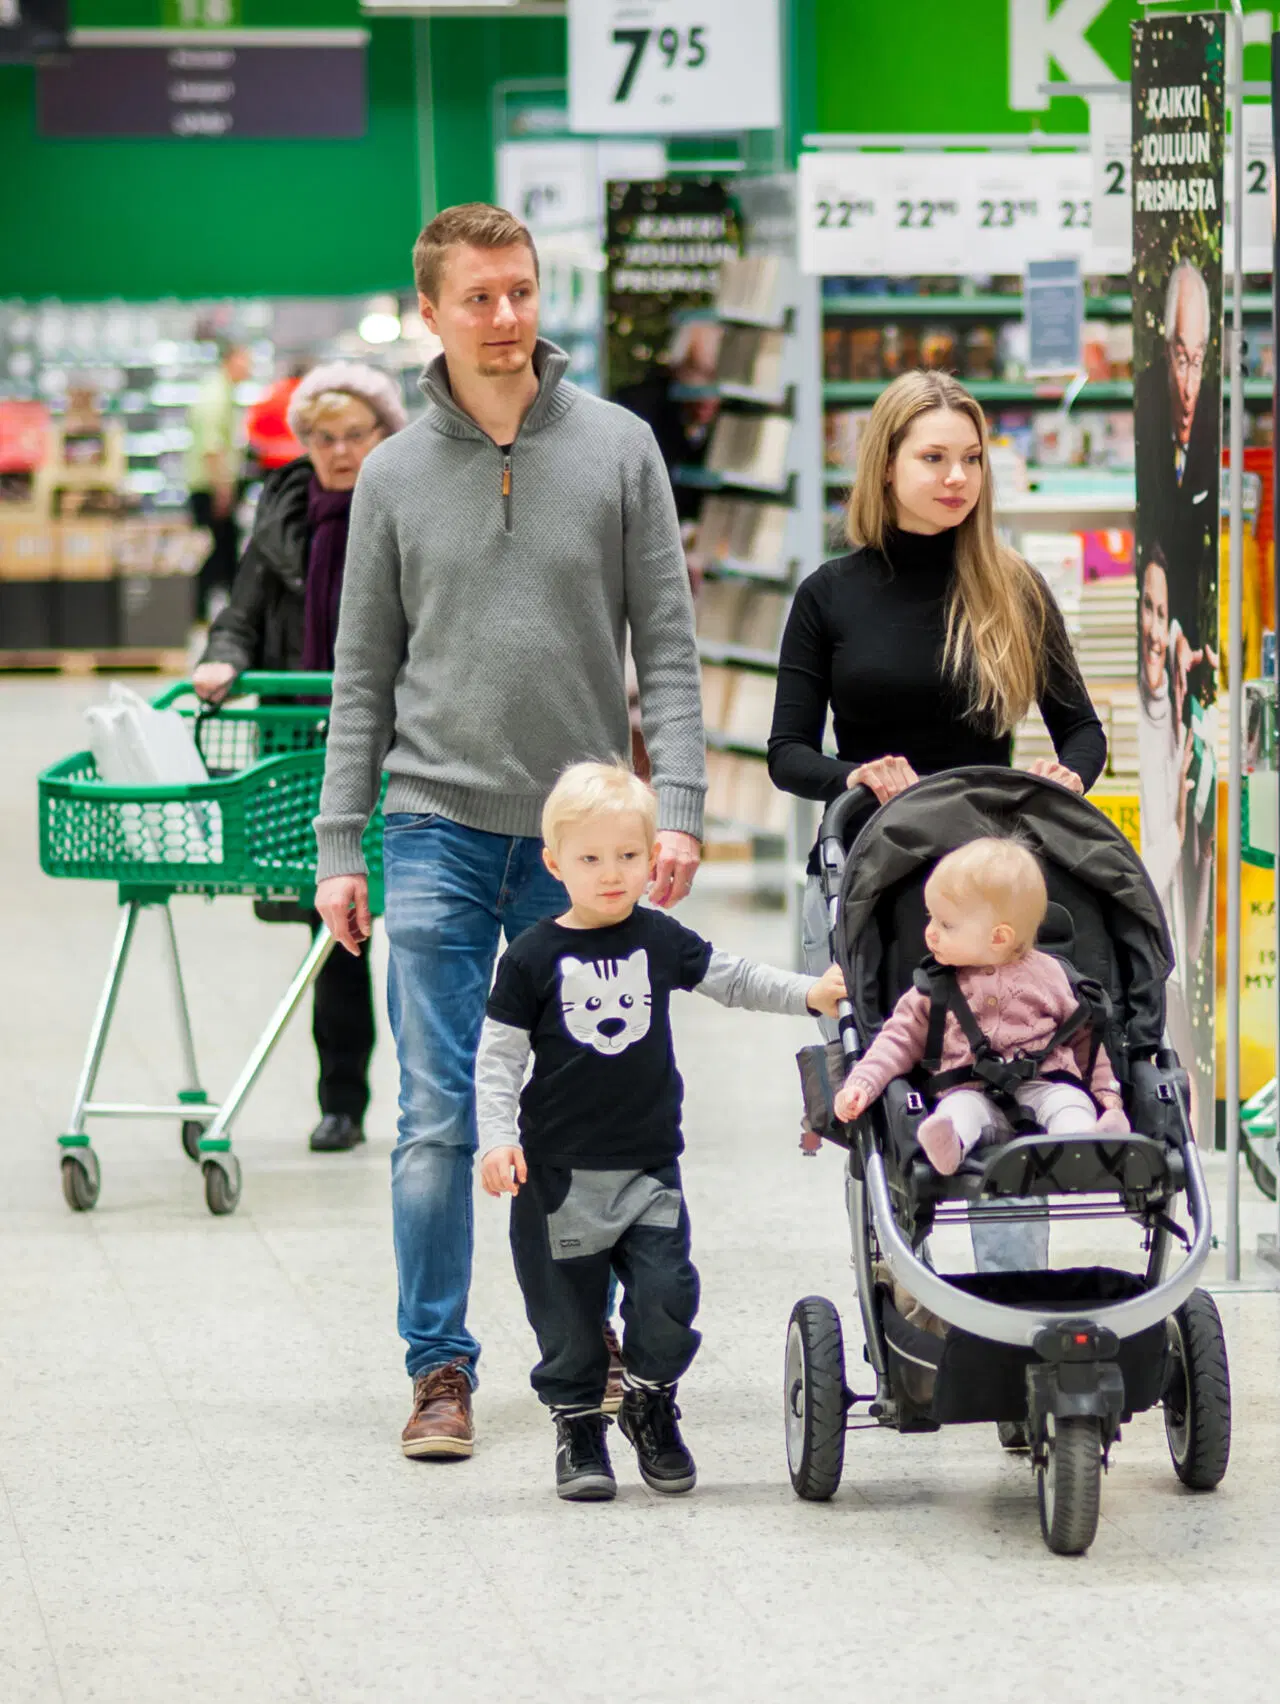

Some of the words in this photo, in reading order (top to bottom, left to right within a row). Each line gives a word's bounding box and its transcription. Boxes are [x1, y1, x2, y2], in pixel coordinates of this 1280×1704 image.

[1146, 85, 1201, 120] KAIKKI
[1141, 132, 1211, 167] JOULUUN
[1135, 178, 1217, 213] PRISMASTA
